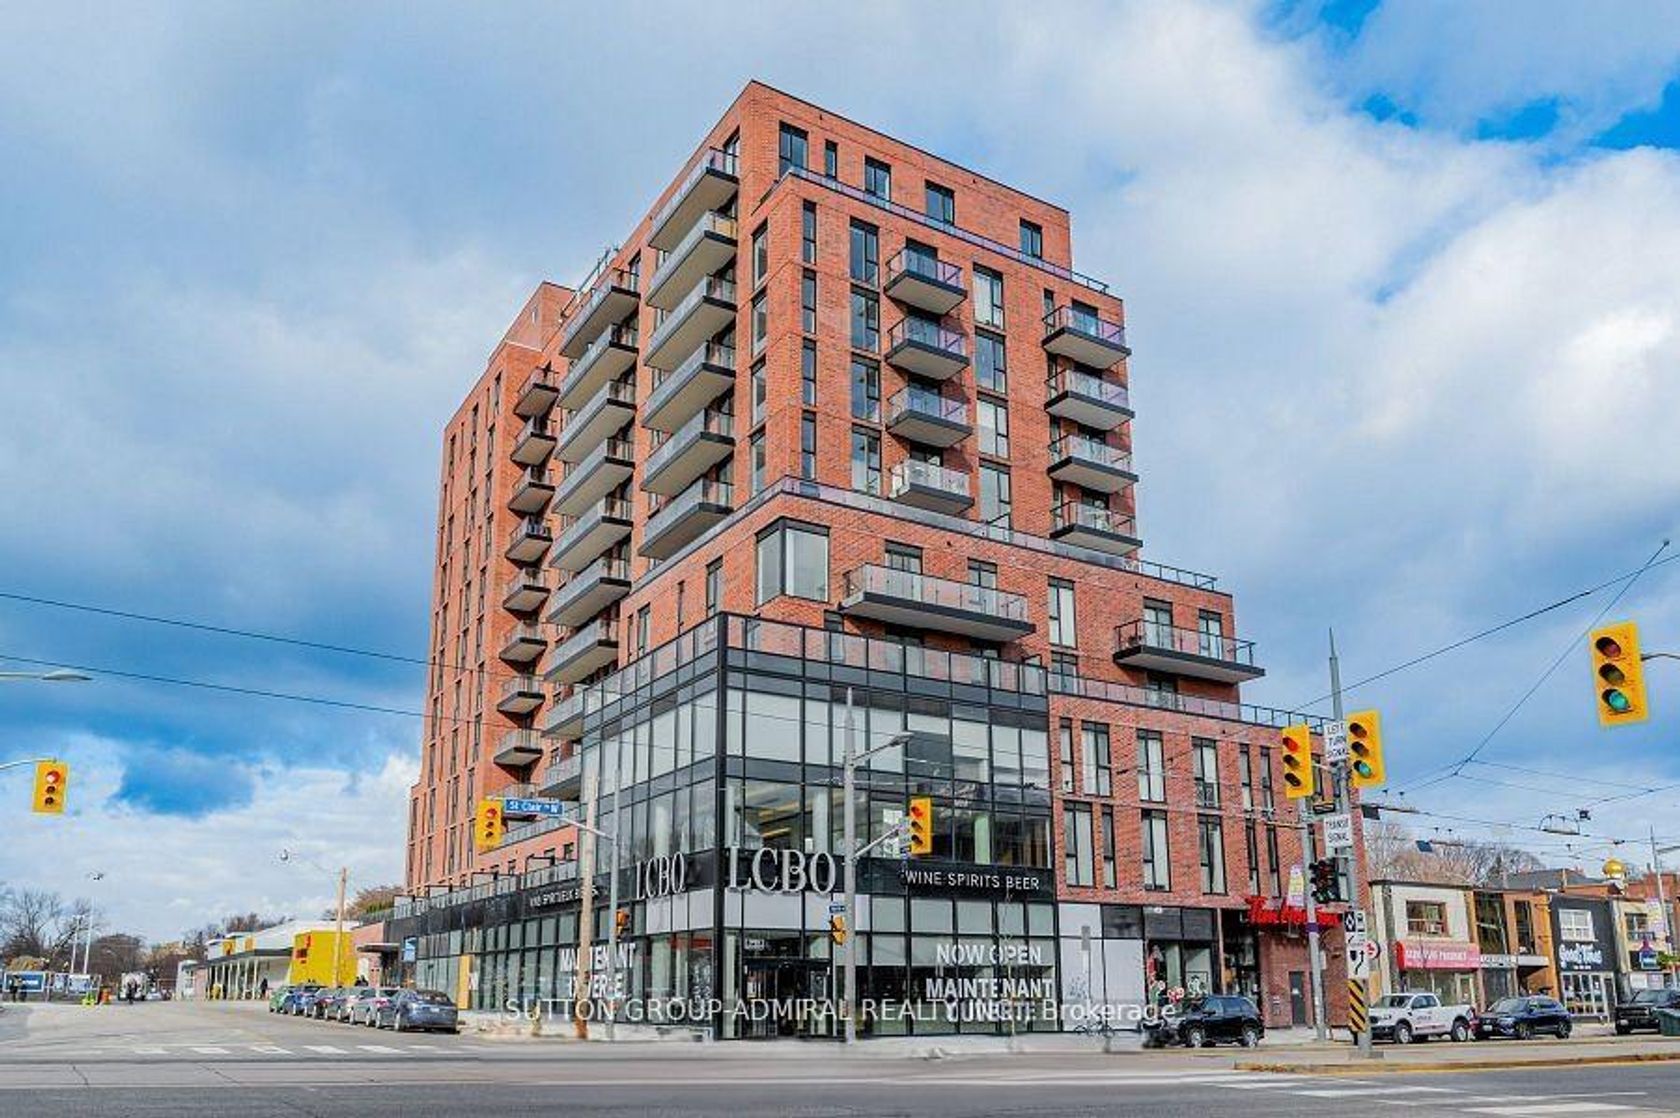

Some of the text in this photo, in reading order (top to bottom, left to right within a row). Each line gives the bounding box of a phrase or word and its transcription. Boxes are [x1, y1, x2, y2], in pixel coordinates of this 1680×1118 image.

[636, 851, 685, 900] LCBO
[729, 846, 836, 895] LCBO
[905, 869, 1040, 891] WINE SPIRITS BEER
[936, 943, 1042, 966] NOW OPEN
[925, 978, 1054, 999] MAINTENANT
